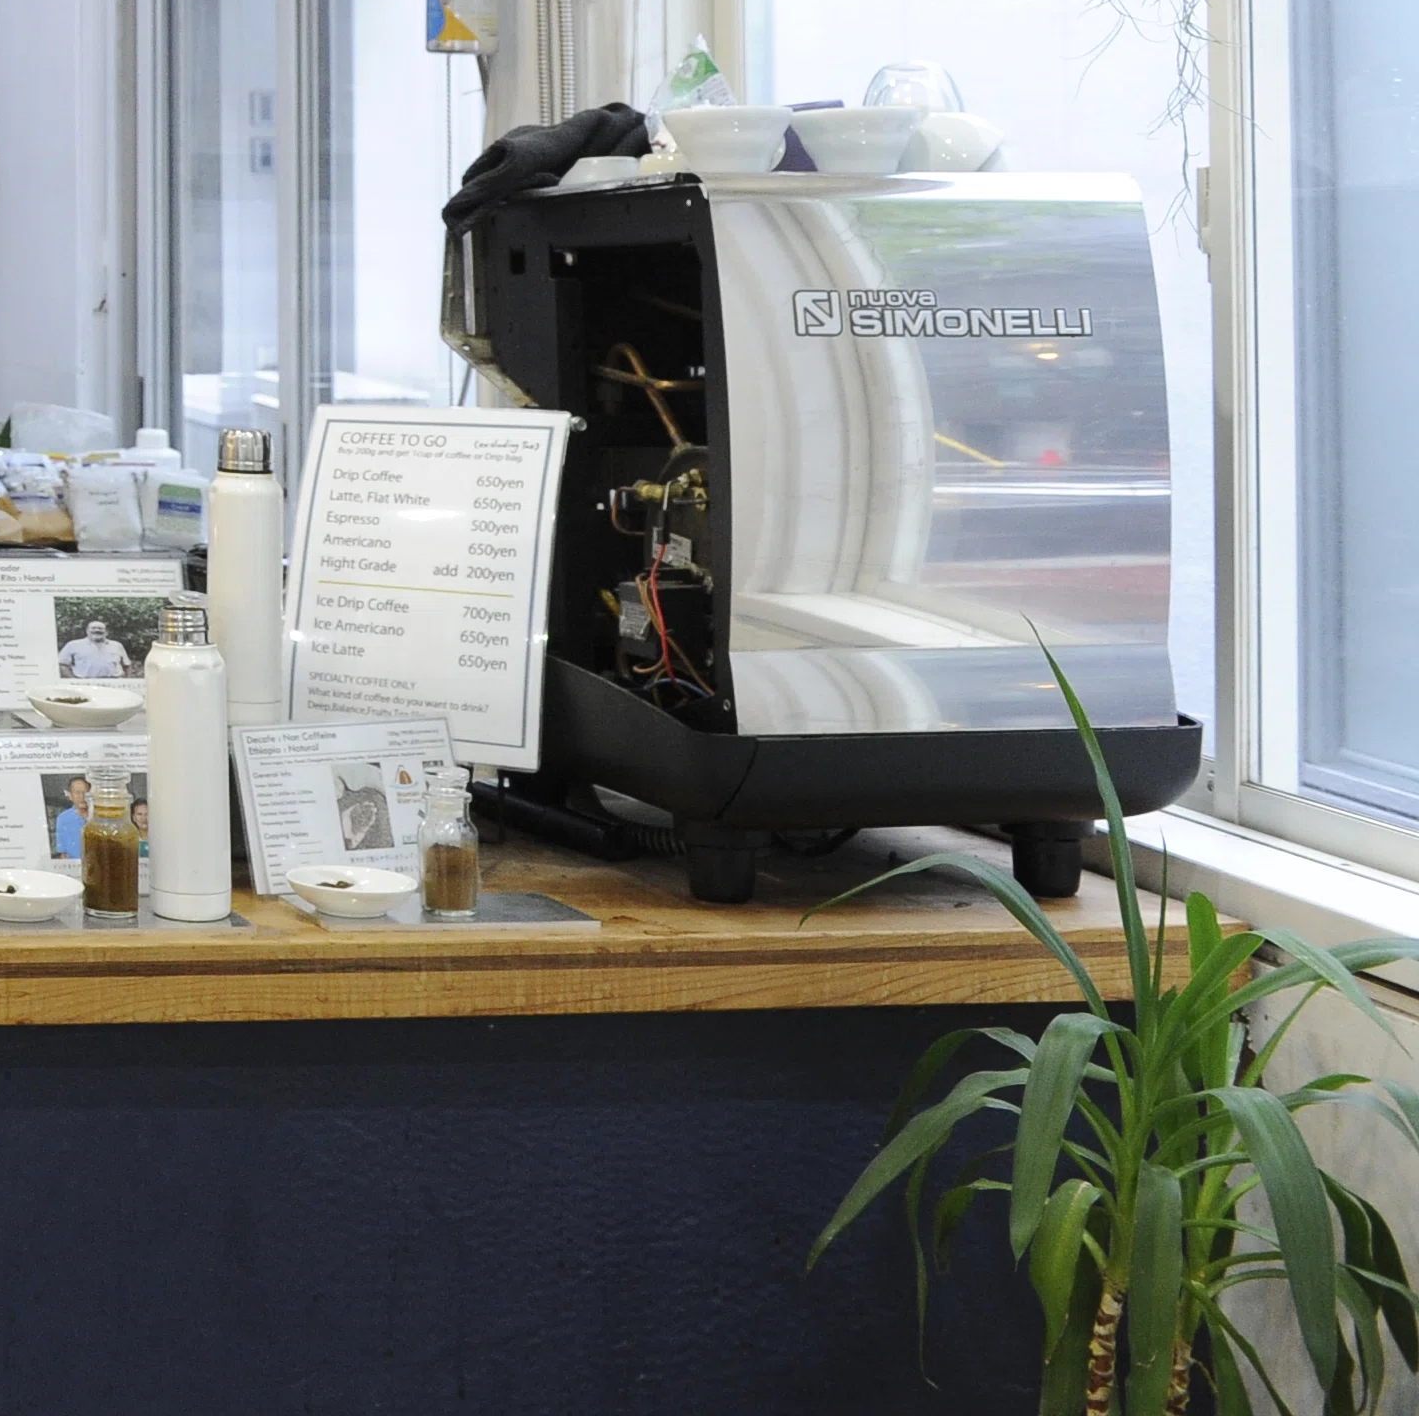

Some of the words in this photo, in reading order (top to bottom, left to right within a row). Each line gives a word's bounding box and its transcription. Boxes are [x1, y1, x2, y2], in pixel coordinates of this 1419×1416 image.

[847, 289, 937, 307] nuova
[850, 308, 1093, 336] SIMONELLI
[340, 432, 395, 445] COFFEE
[401, 434, 420, 447] TO
[423, 435, 447, 447] GO
[378, 448, 394, 457] and
[435, 450, 444, 458] of
[445, 451, 471, 460] coffee
[333, 469, 359, 482] Drip
[363, 470, 403, 483] Coffee
[476, 477, 524, 491] 650yen
[330, 490, 363, 503] Latte,
[367, 491, 391, 503] Flat
[395, 494, 430, 506] White
[473, 498, 521, 512] 650yen
[326, 512, 380, 526] Espresso
[471, 520, 519, 535] 500yen
[323, 534, 391, 550] Americano
[468, 543, 517, 559] 650yen
[24, 574, 55, 582] Natural
[320, 556, 355, 572] Hight
[359, 559, 397, 572] Grade
[433, 565, 458, 577] add
[466, 567, 515, 582] 200yen
[316, 595, 333, 608] Ice
[338, 597, 364, 612] Drip
[368, 598, 410, 614] Coffee
[463, 606, 511, 623] 700yen
[314, 618, 331, 632] Ice
[335, 620, 404, 637] Americano
[460, 631, 509, 647] 650yen
[312, 642, 329, 655] Ice
[332, 644, 365, 657] Latte
[458, 655, 507, 671] 650yen
[309, 672, 354, 684] SPECIALTY
[355, 676, 388, 687] COFFEE
[391, 680, 416, 690] ONLY
[308, 688, 330, 697] What
[333, 690, 351, 699] kind
[353, 691, 362, 700] of
[365, 693, 390, 703] coffee
[393, 696, 404, 704] do
[406, 699, 423, 708] you
[425, 700, 447, 709] want
[449, 702, 459, 710] to
[248, 746, 281, 755] Ethiopia
[288, 744, 319, 753] Natural
